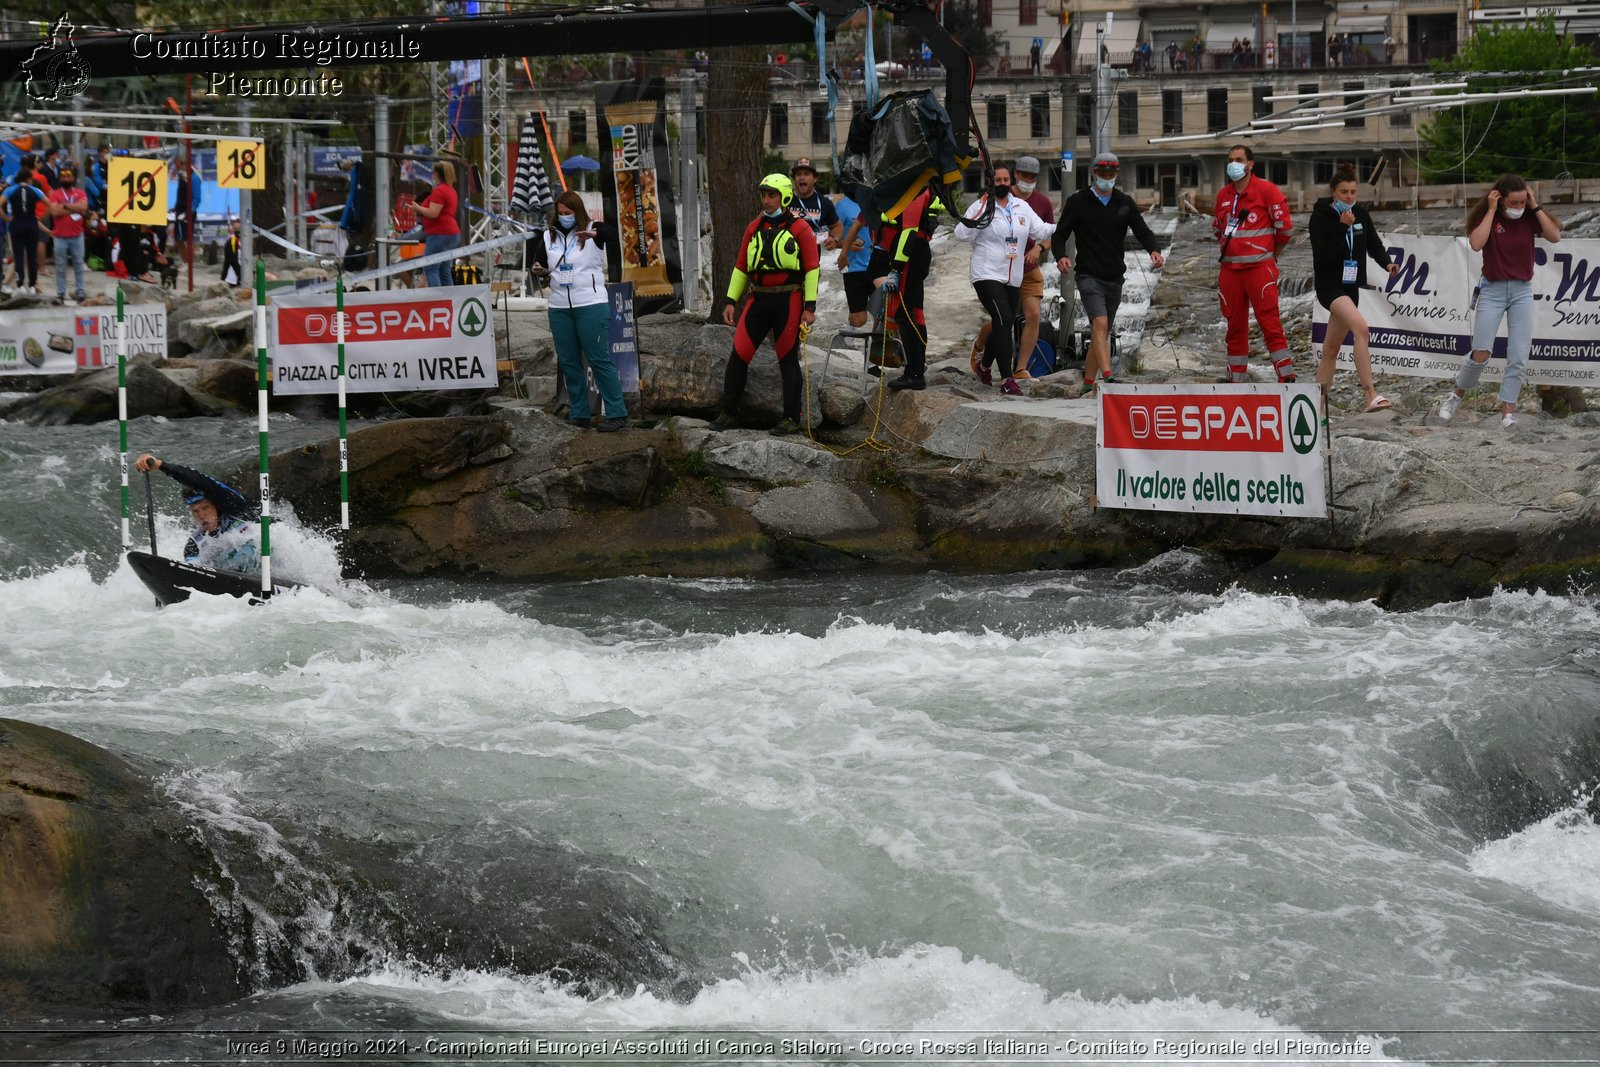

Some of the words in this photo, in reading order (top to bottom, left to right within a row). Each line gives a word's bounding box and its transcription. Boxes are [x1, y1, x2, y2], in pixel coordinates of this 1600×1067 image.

[622, 125, 639, 169] KIND
[228, 149, 256, 179] 18
[121, 171, 156, 211] 19
[634, 183, 642, 195] SALT
[636, 210, 644, 231] ALMOND
[638, 232, 646, 254] CARAMEL
[1386, 291, 1447, 319] Service
[305, 307, 451, 337] DESPAR
[278, 365, 327, 382] PIAZZA
[348, 362, 388, 380] CITTA'
[393, 361, 408, 379] 21
[418, 356, 486, 381] IVREA
[1381, 356, 1420, 369] PROVIDER
[1540, 369, 1595, 379] PROGETTAZIONE
[1129, 405, 1280, 441] DESPAR
[1116, 468, 1126, 497] Il
[1130, 470, 1186, 500] valore
[1192, 472, 1240, 502] della
[1247, 474, 1304, 505] scelta
